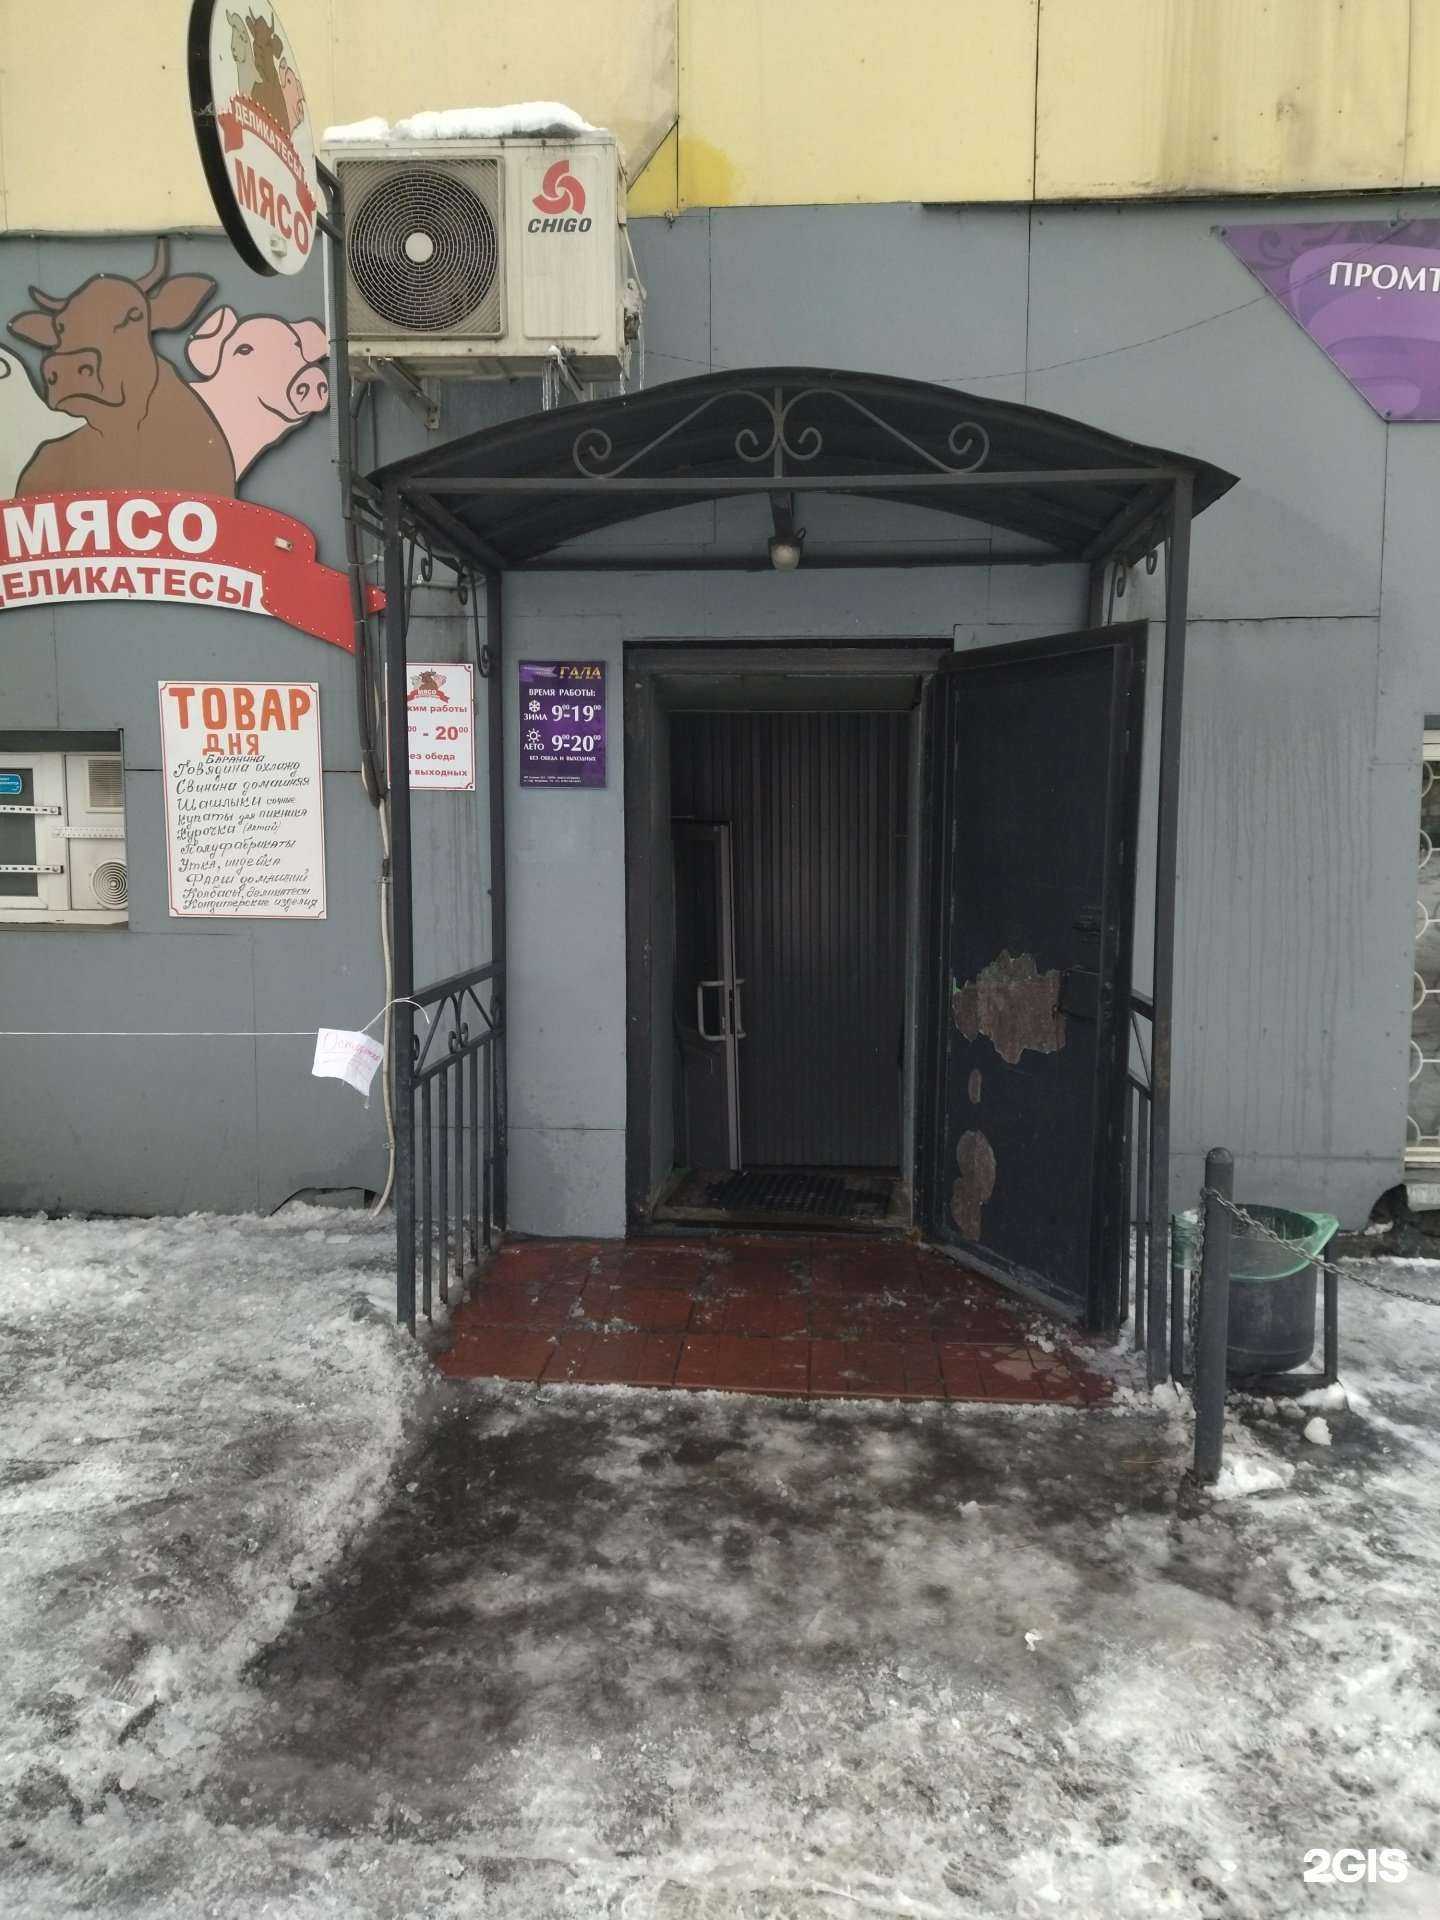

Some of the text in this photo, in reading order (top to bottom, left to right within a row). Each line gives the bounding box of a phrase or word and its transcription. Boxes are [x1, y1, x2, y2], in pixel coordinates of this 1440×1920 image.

[235, 101, 304, 179] ДЕЛИКАТЕСЫ
[235, 158, 309, 255] МЯСО
[528, 218, 592, 233] CHIGO
[1329, 262, 1440, 292] ПРОМТ
[3, 499, 217, 557] МЯСО
[0, 566, 253, 608] ЕЛИКАТЕСЫ
[559, 667, 601, 679] ГАЛА
[559, 689, 595, 697] РАБОТЫ:
[169, 688, 311, 731] ТОВАР
[430, 704, 467, 714] работы
[203, 734, 260, 756] ДНЯ
[523, 743, 545, 751] ЛЕТО
[425, 752, 455, 762] обеда
[176, 778, 310, 795] Свинина домашняя
[177, 796, 262, 812] Шашлыки
[180, 837, 296, 858] Полуфабрикаты
